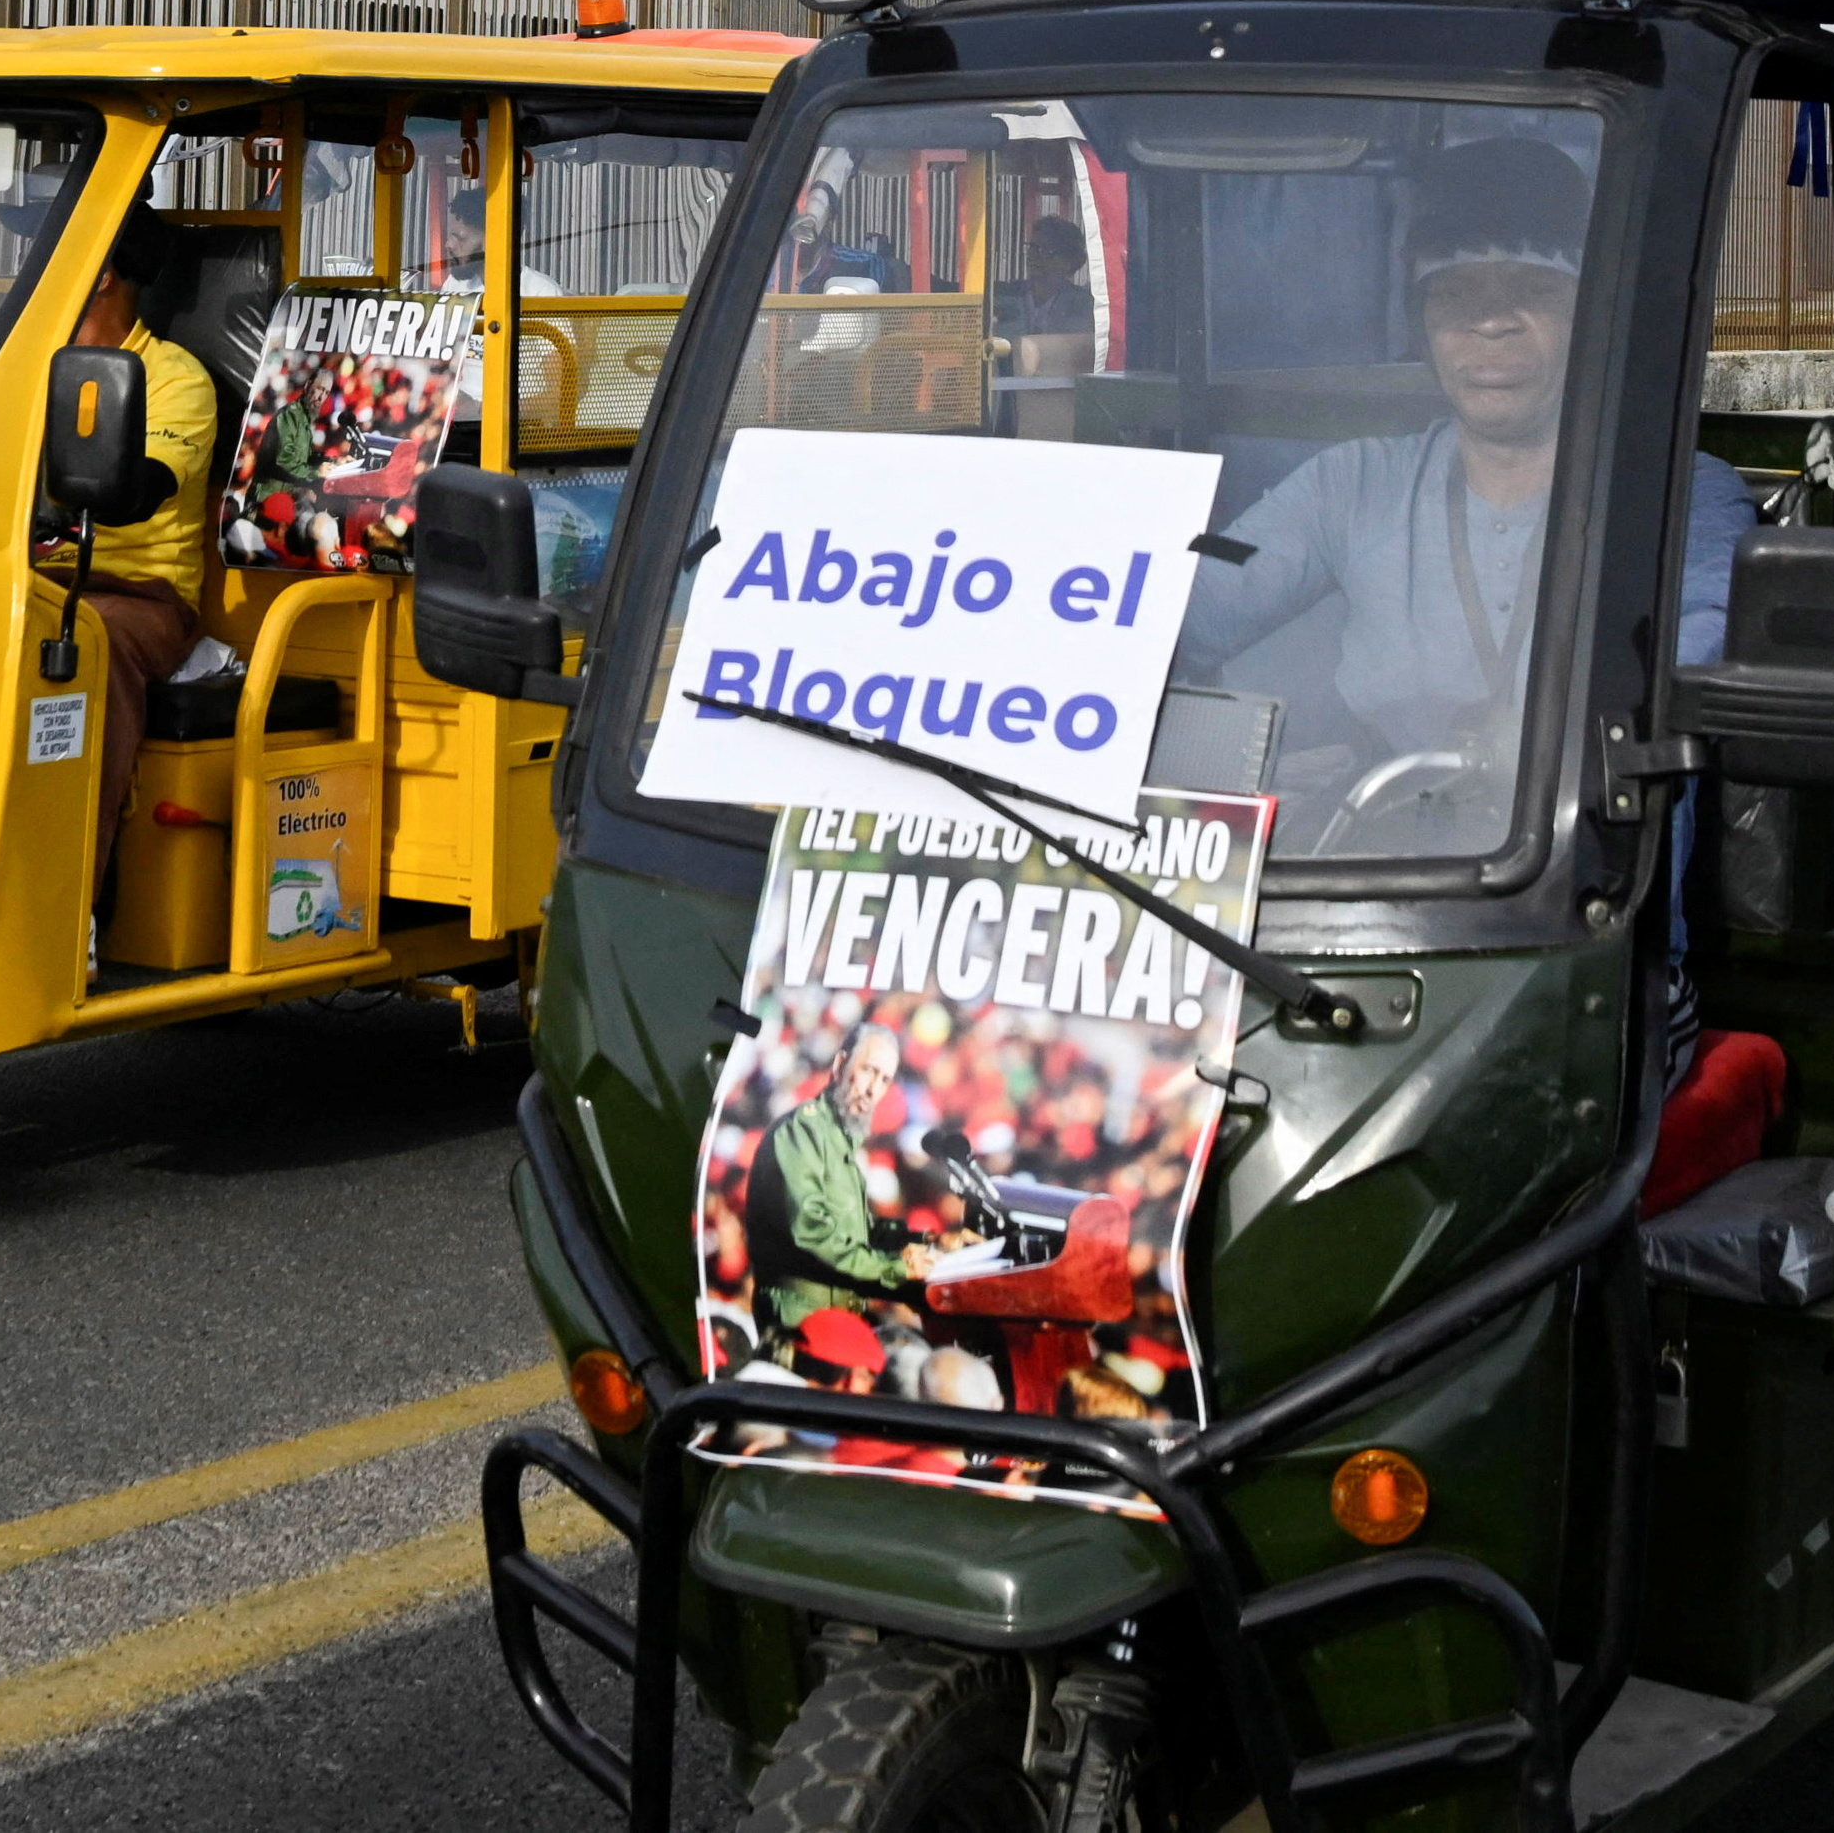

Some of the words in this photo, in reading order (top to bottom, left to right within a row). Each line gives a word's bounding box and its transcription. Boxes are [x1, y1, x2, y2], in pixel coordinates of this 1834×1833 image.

[285, 295, 464, 361] VENCERÁ!
[723, 529, 1013, 629] Abajo
[1049, 551, 1152, 627] el
[696, 647, 1118, 752] Bloqueo
[278, 808, 347, 835] Eléctrico
[279, 777, 320, 801] 100%
[870, 810, 1034, 863] PUEBLO
[1045, 814, 1231, 883] BANO
[783, 868, 1218, 1030] VENCERÁ!
